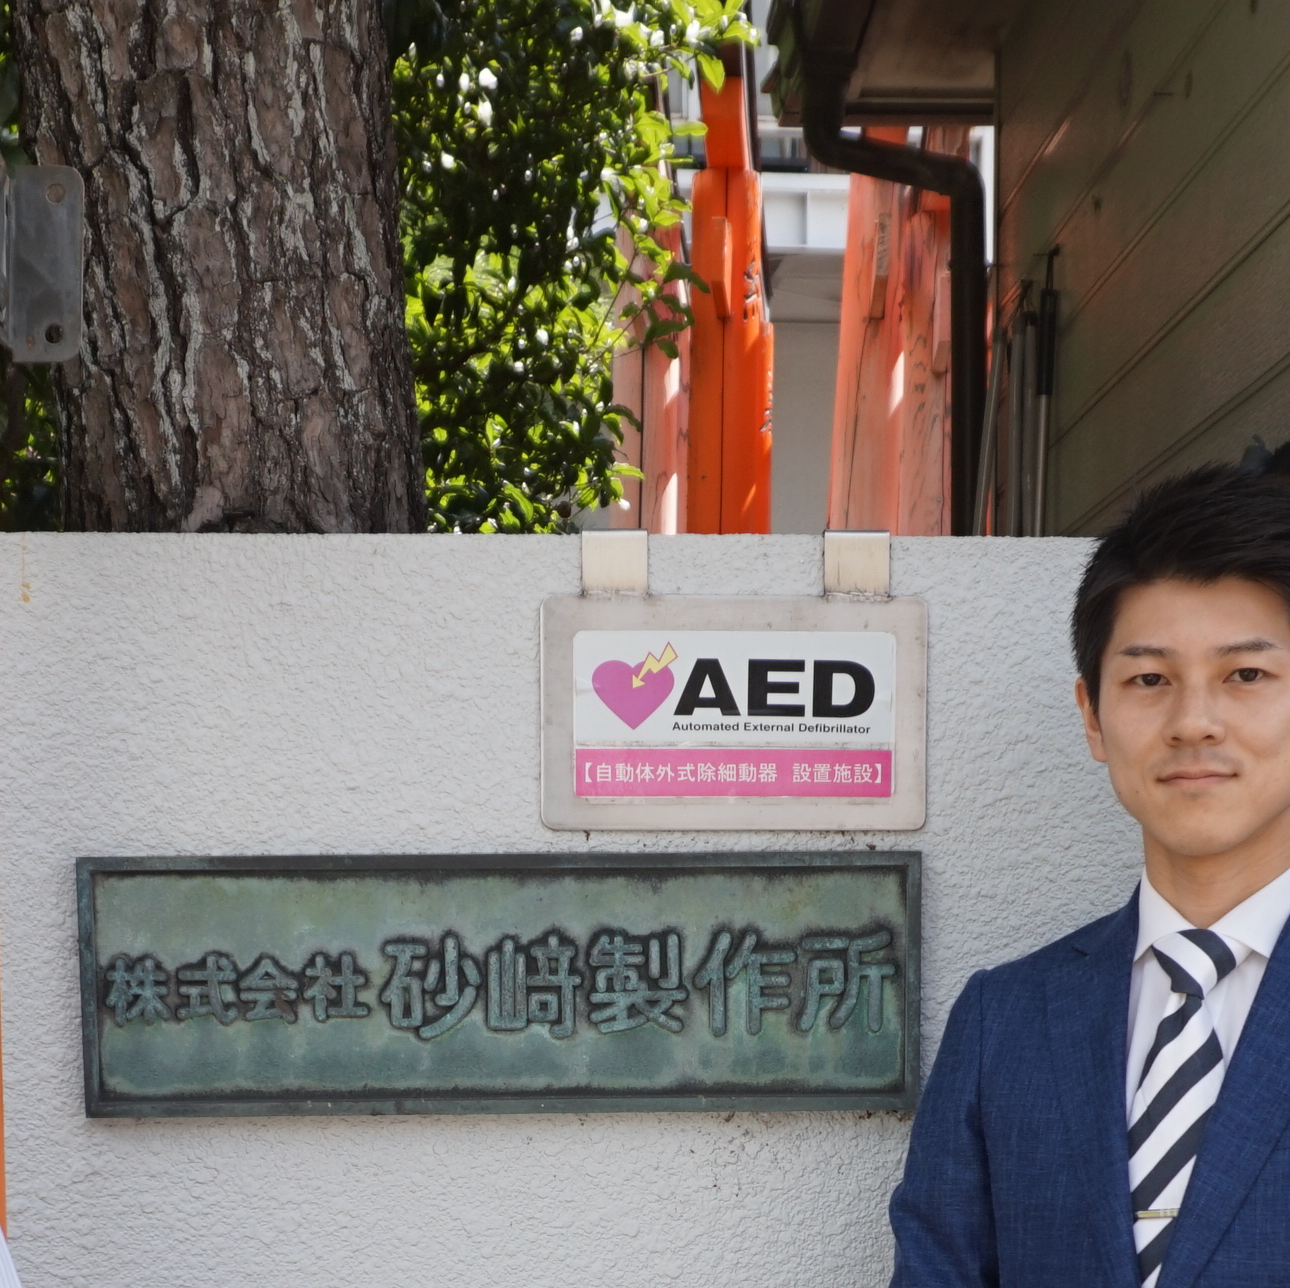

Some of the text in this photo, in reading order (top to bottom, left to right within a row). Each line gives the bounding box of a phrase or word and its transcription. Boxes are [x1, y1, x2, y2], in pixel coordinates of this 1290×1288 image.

[673, 658, 876, 718] AED
[672, 721, 871, 734] Automated External Defibrillator
